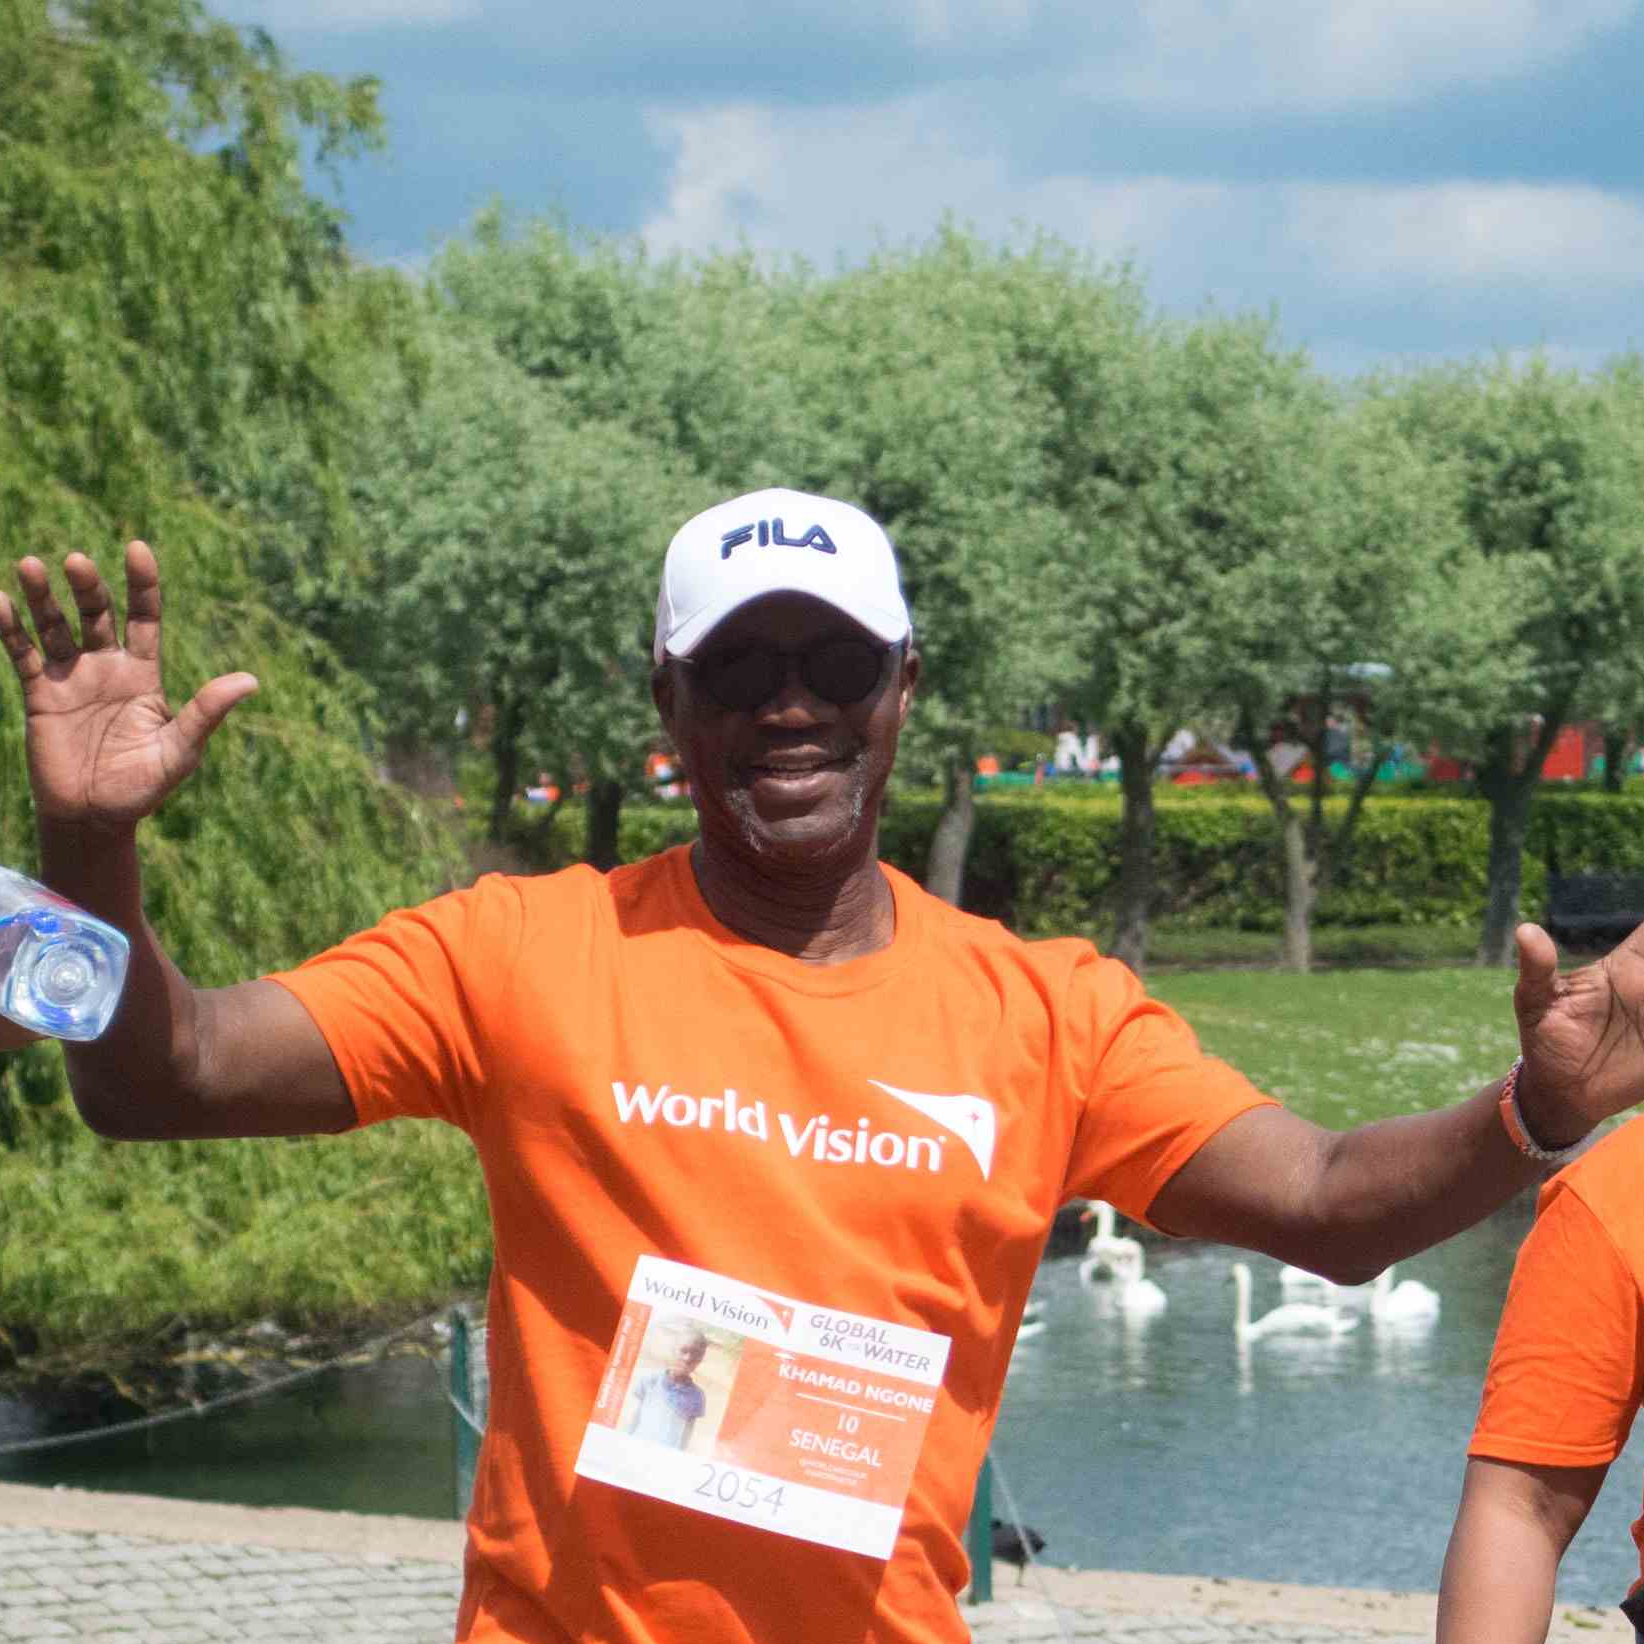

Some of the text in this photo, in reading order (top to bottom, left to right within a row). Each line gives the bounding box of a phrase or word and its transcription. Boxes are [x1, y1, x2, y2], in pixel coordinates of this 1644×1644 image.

[720, 517, 838, 560] FILA
[611, 1081, 942, 1172] World Vision
[645, 1277, 769, 1330] World Vision
[810, 1314, 888, 1345] GLOBAL
[819, 1332, 844, 1352] 6K
[864, 1342, 932, 1372] WATER
[778, 1362, 934, 1414] KHAMAD NGONE
[837, 1413, 860, 1433] 10
[789, 1429, 882, 1467] SENEGAL
[694, 1463, 786, 1517] 2054
